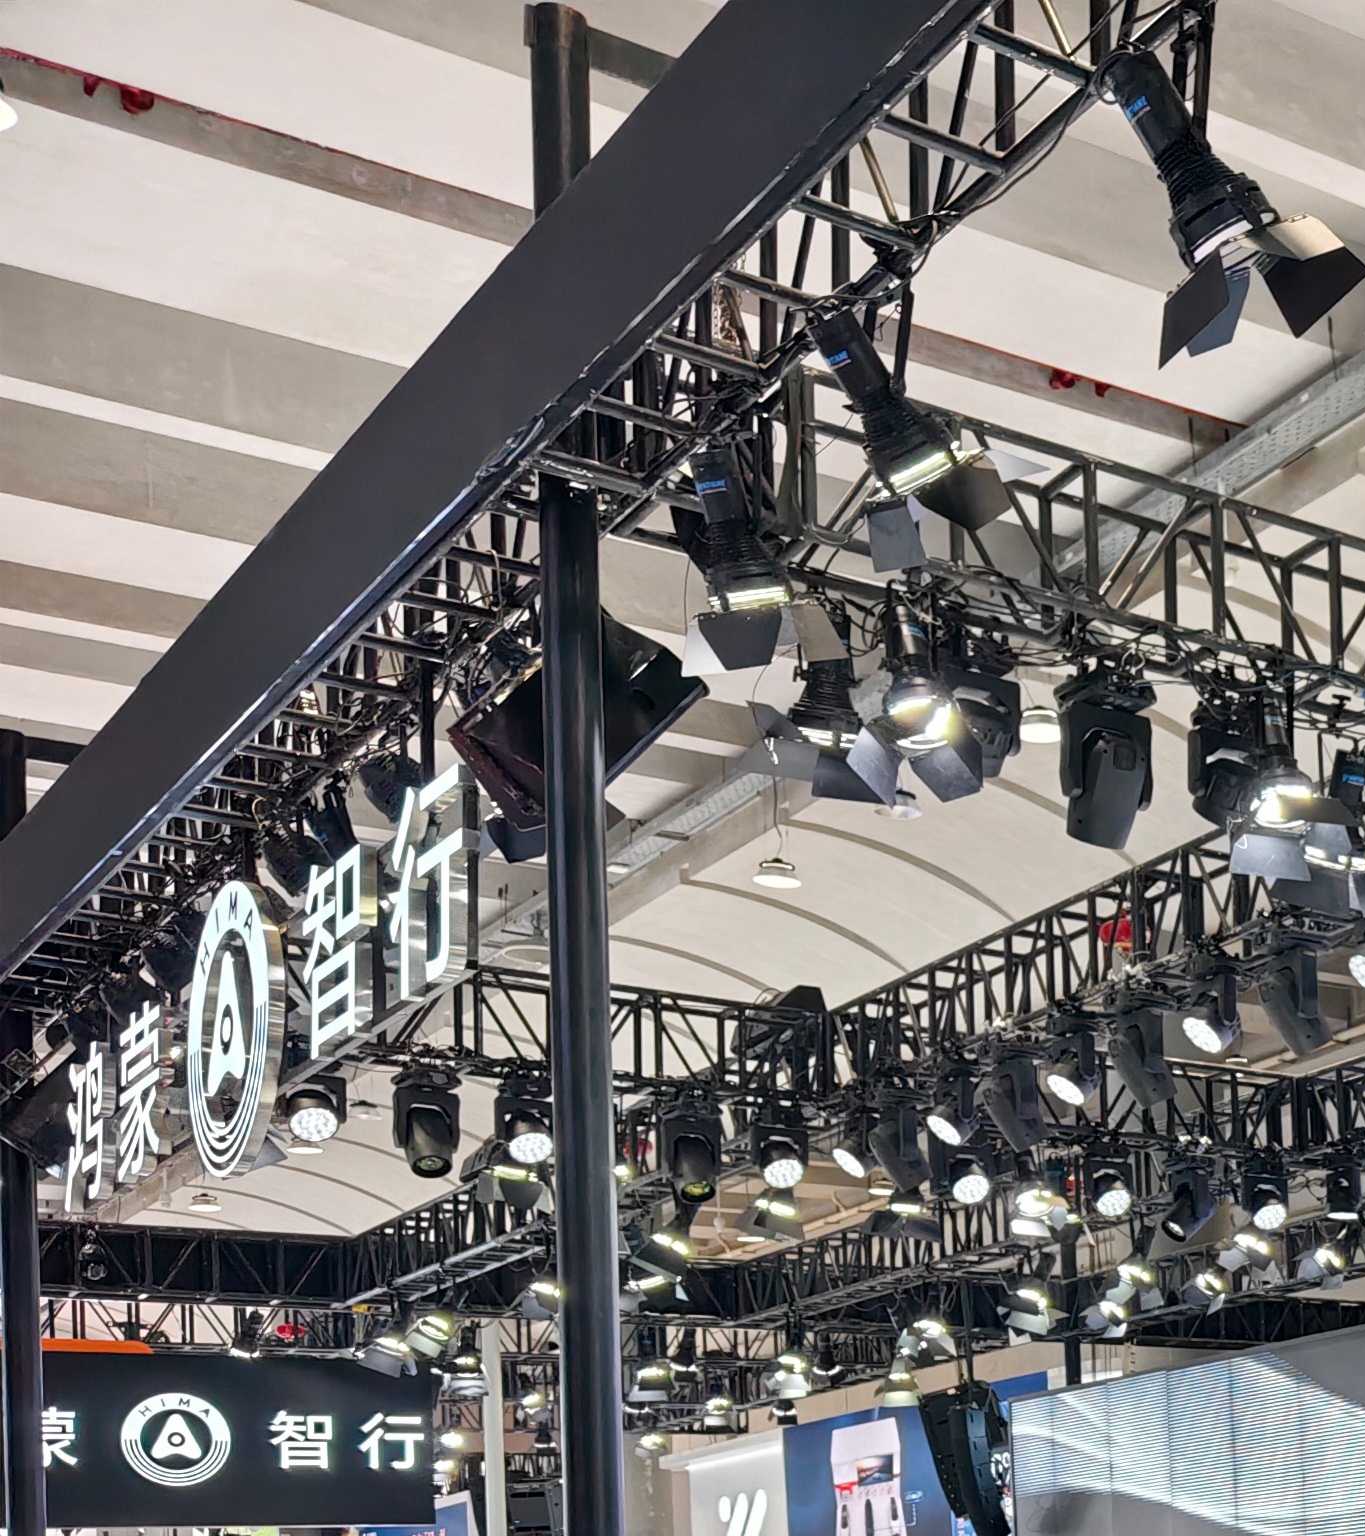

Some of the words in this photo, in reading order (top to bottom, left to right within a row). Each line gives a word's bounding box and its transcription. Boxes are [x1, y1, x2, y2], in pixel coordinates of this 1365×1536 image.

[65, 1000, 160, 1213] 鸿蒙
[302, 762, 464, 1061] 智行
[138, 1397, 210, 1418] HIMA
[268, 1410, 425, 1470] 智行
